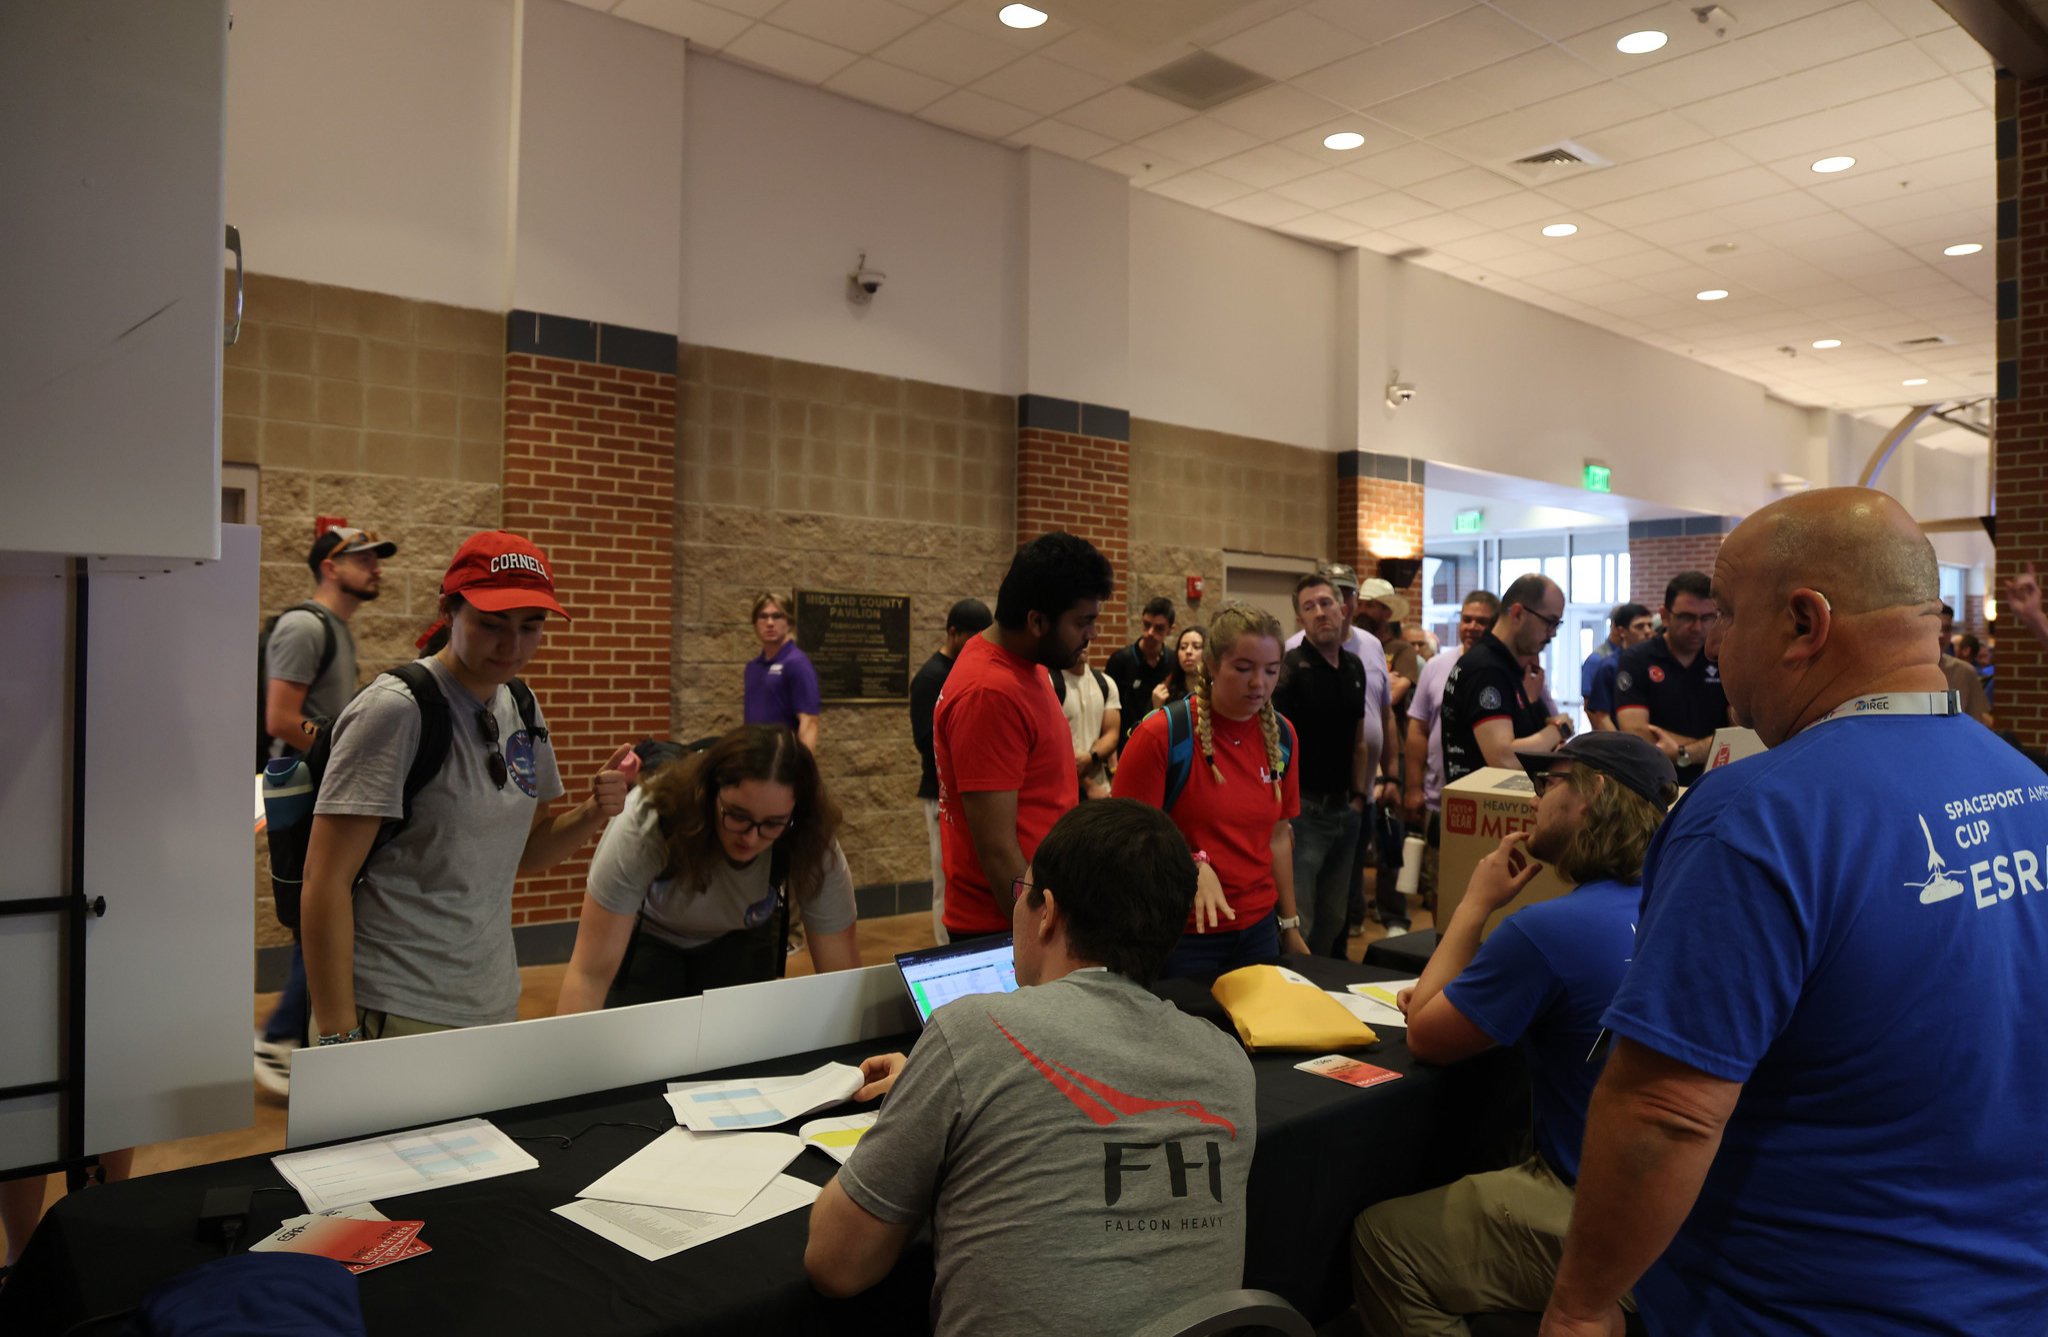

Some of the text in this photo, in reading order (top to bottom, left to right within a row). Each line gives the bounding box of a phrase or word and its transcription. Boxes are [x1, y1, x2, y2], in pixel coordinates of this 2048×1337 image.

[491, 553, 549, 580] CORNELL
[806, 593, 904, 609] MIDLAND COUNTY
[830, 607, 881, 619] PAVILION
[1867, 702, 1889, 710] IREC
[1484, 800, 1518, 813] HEAVY
[1945, 785, 2048, 820] SPACEPORT AME
[1451, 815, 1472, 829] GEAR
[1955, 820, 1990, 849] CUP
[1970, 845, 2048, 910] ESR
[1104, 1142, 1223, 1207] FH
[1105, 1217, 1223, 1232] FALCON HEAVY
[362, 1226, 413, 1260] ROCKETEER
